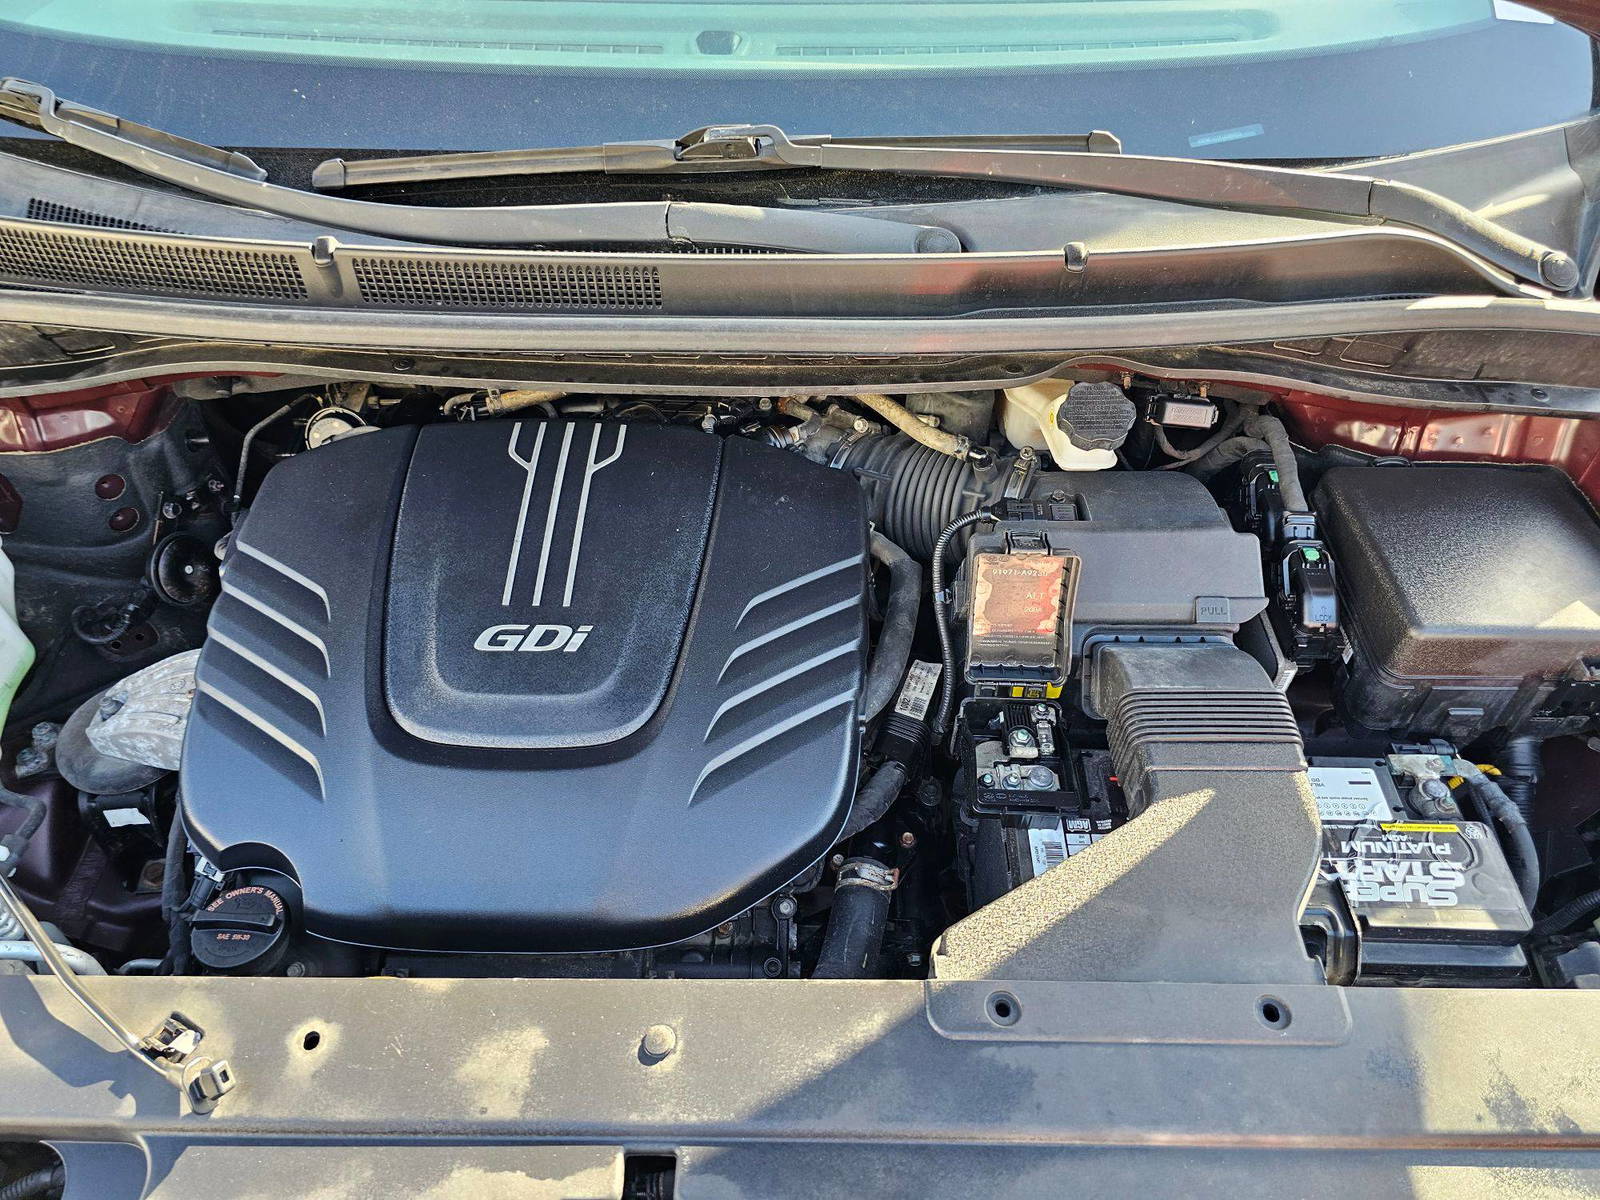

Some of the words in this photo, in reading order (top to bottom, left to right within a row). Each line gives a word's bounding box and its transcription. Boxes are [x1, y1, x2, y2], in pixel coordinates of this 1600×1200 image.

[1200, 605, 1228, 616] PULL
[1314, 613, 1331, 622] LOCK
[473, 624, 594, 652] GDi
[1340, 840, 1452, 855] PLATINUM
[207, 897, 225, 912] SEE
[225, 886, 264, 899] OWNER'S
[264, 890, 284, 915] MANUAL
